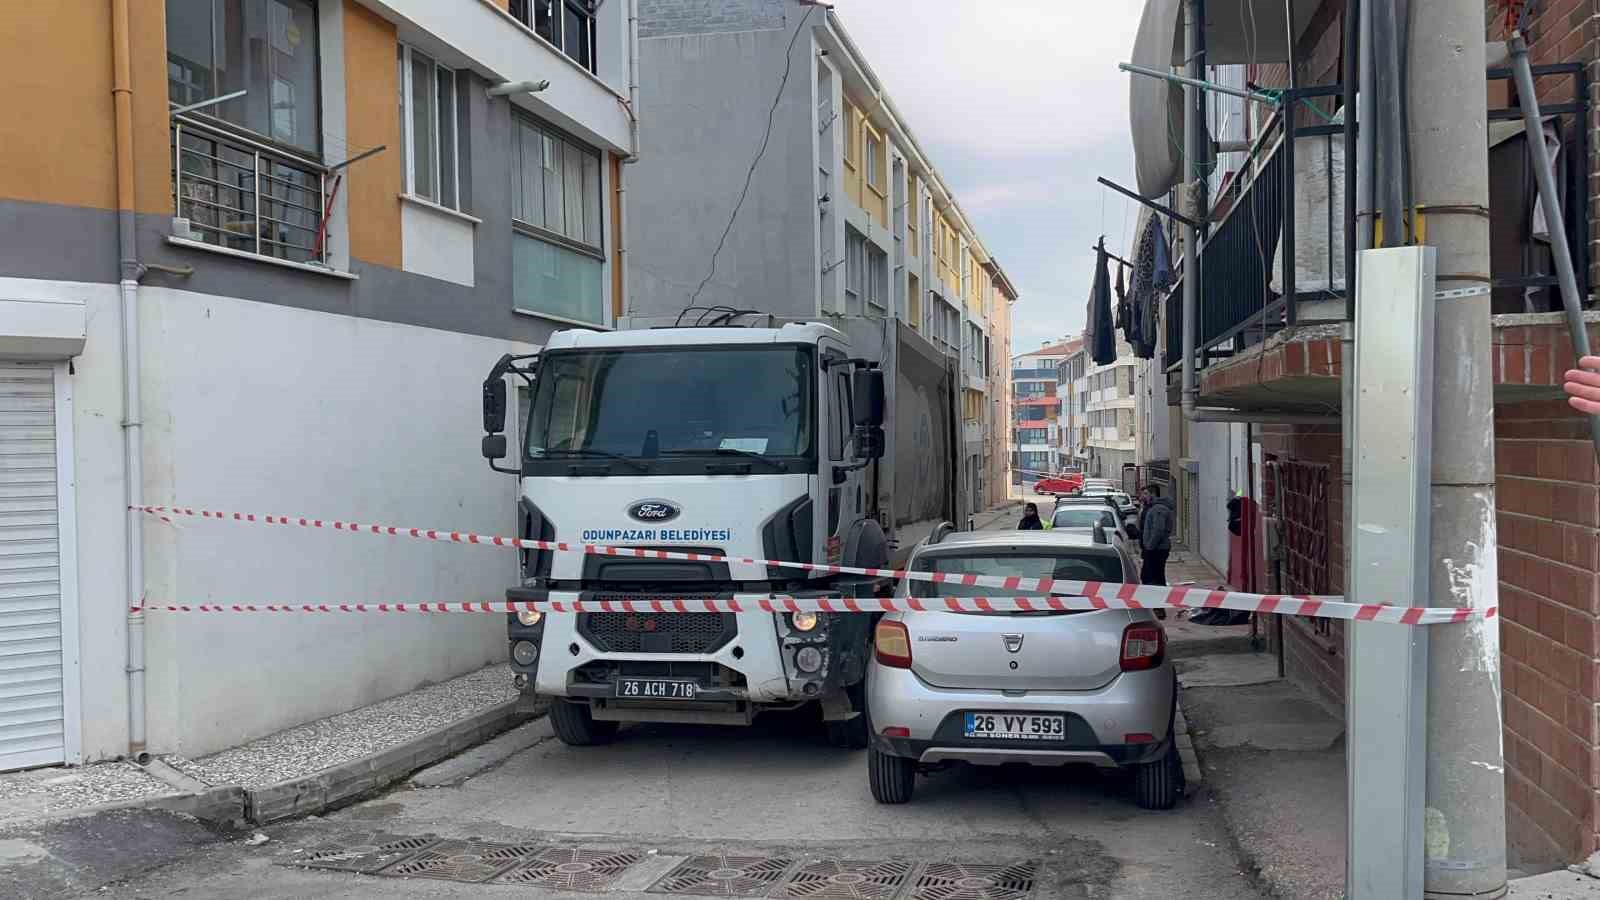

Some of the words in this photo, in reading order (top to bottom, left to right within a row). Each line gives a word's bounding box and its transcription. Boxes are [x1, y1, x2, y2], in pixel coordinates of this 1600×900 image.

[582, 530, 656, 541] ODUNPAZARI
[660, 528, 731, 541] BELEDİYESİ
[624, 682, 639, 695] 26
[644, 682, 666, 696] ACH
[671, 683, 693, 697] 718
[975, 716, 995, 733] 26
[1003, 716, 1026, 733] VY
[1031, 717, 1063, 734] 593
